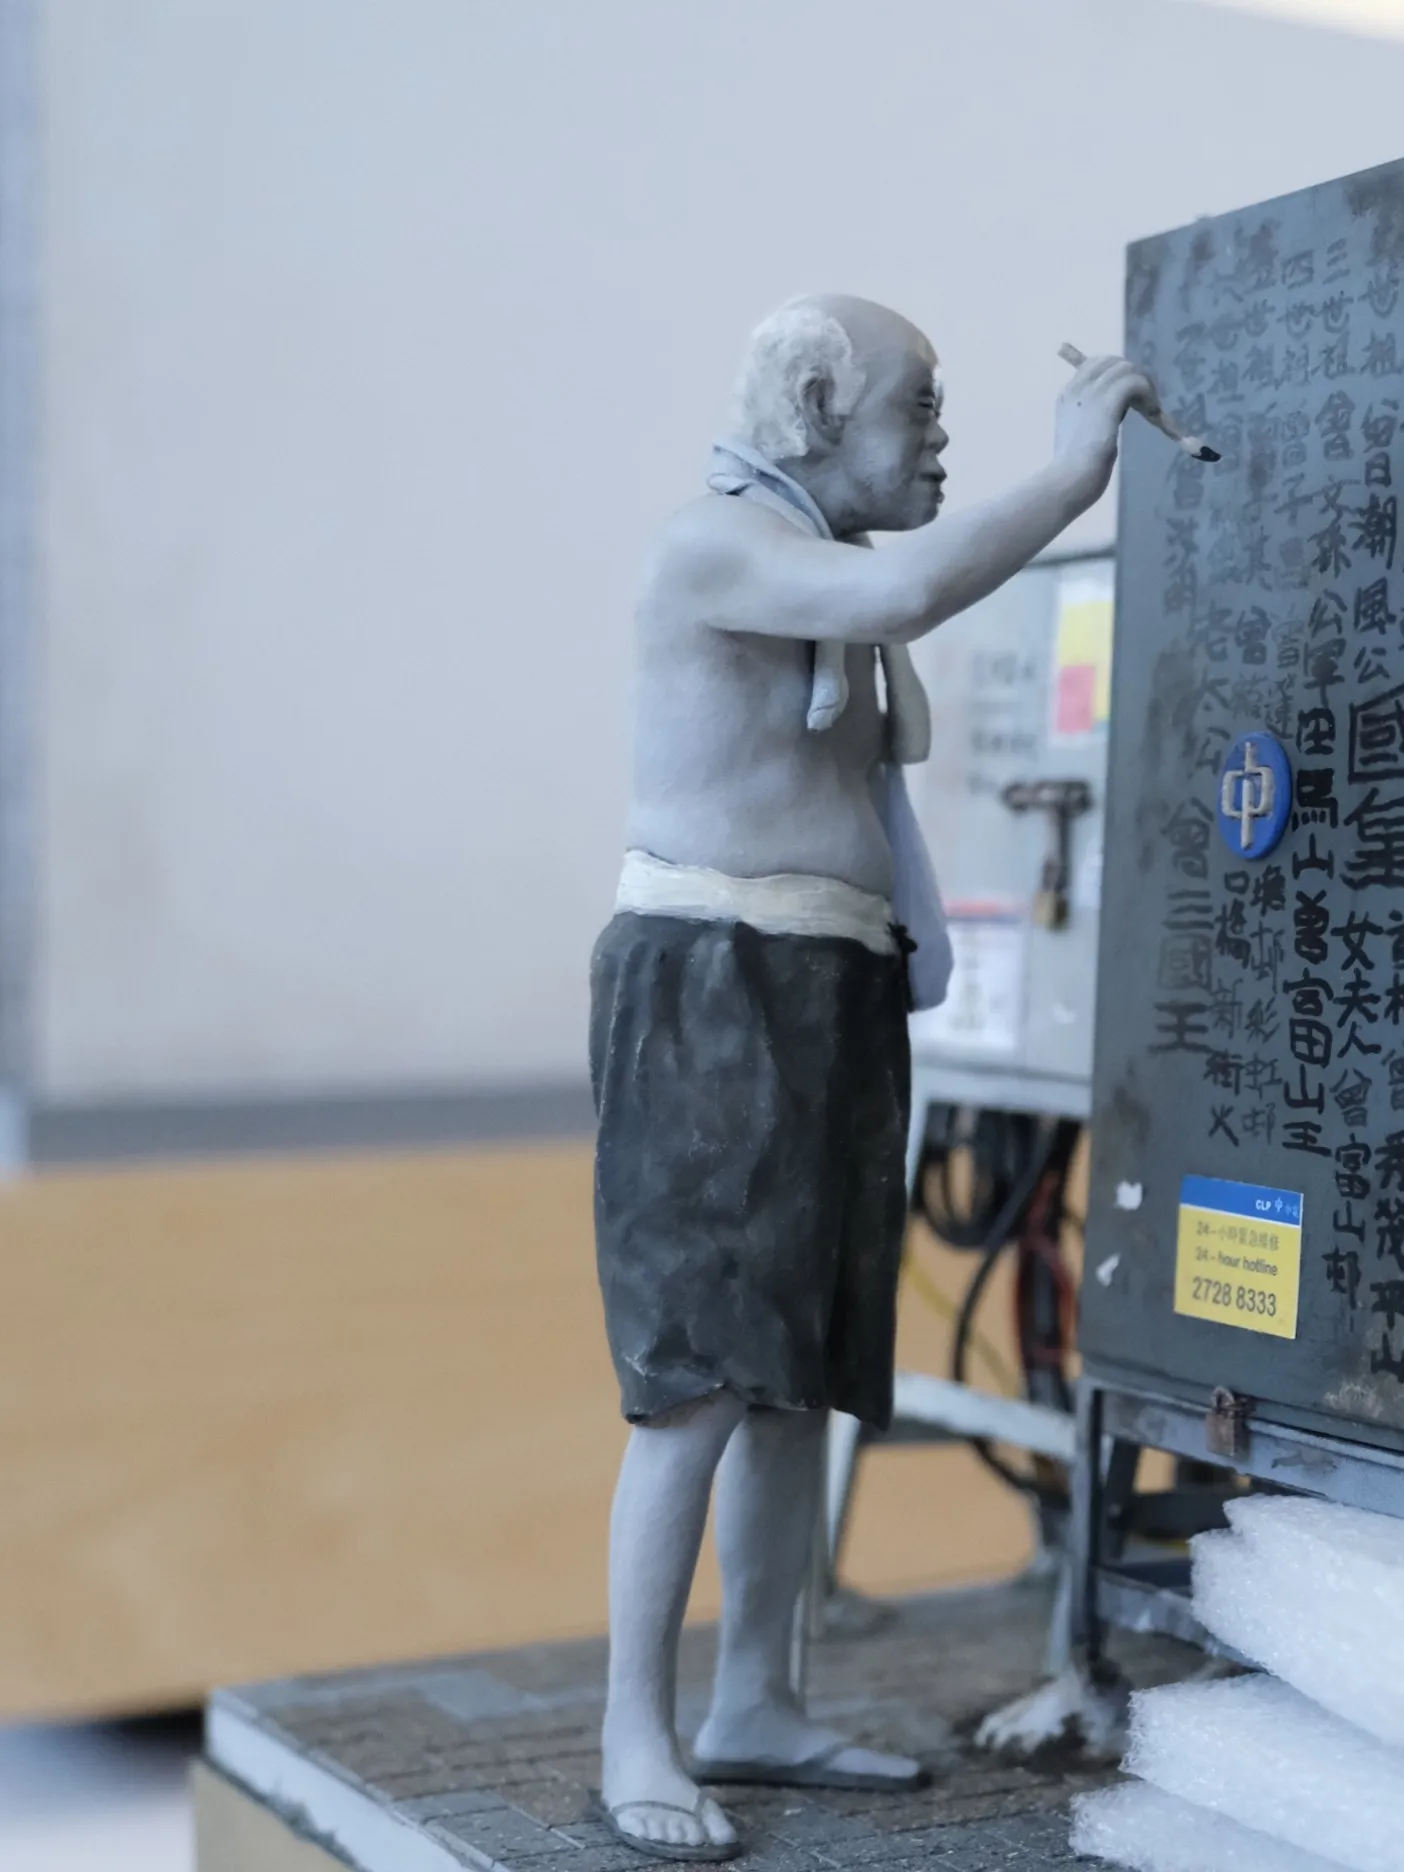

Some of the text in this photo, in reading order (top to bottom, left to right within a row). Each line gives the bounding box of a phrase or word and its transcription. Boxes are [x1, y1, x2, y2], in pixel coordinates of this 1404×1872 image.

[1255, 1199, 1272, 1213] CLP
[1242, 1255, 1278, 1277] hotline
[1192, 1276, 1277, 1318] 2728 8333
